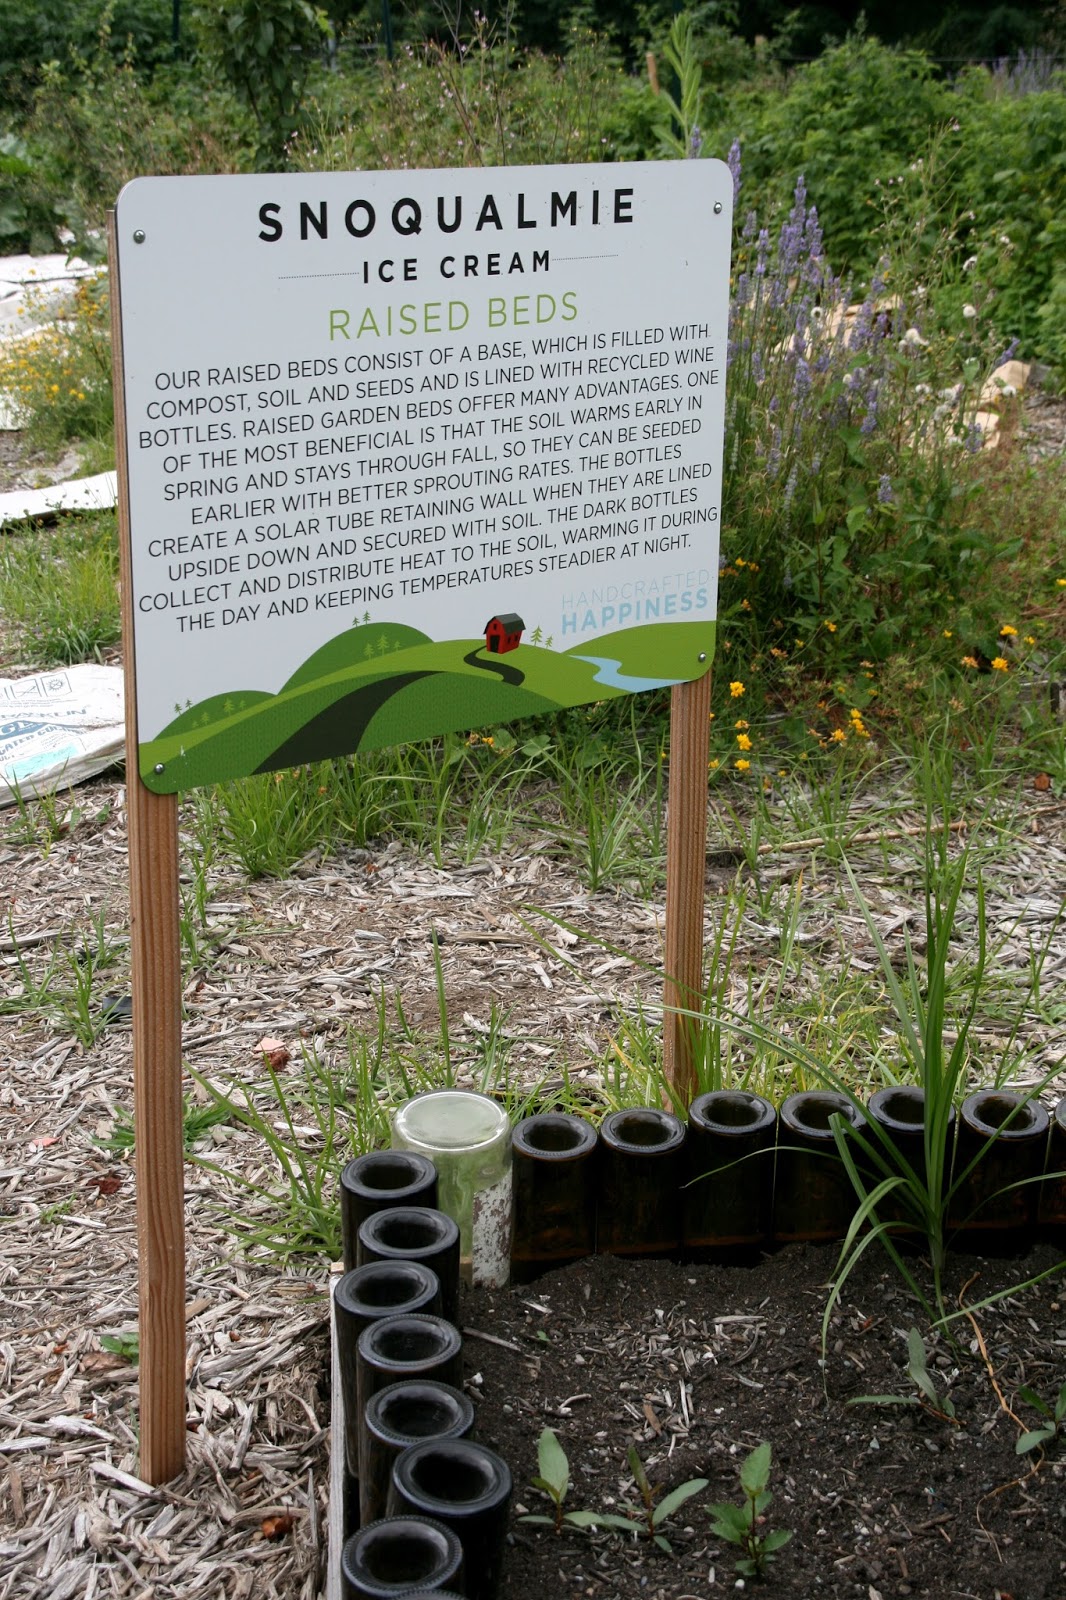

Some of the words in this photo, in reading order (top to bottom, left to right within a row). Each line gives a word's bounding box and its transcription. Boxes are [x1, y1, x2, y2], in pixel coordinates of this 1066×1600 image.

[258, 187, 634, 243] SNOQUALMIE
[363, 257, 418, 284] ICE
[439, 249, 550, 279] CREAM
[329, 300, 470, 341] RAISED
[488, 291, 578, 328] BEDS
[145, 392, 251, 421] COMPOST,
[257, 388, 303, 410] SOIL
[307, 383, 350, 405] AND
[355, 376, 415, 399] SEEDS
[419, 372, 460, 393] AND
[464, 370, 480, 388] IS
[484, 364, 535, 386] LINED
[539, 359, 583, 380] WITH
[587, 351, 670, 375] RECYCLED
[674, 346, 715, 366] WINE
[154, 369, 201, 391] OUR
[207, 362, 282, 387] RAISED
[287, 357, 339, 380] BEDS
[343, 349, 424, 374] CONSIST
[428, 346, 455, 366] OF
[458, 345, 473, 364] A
[477, 340, 527, 361] BASE,
[531, 334, 588, 356] WHICH
[592, 332, 607, 350] IS
[611, 327, 665, 348] FILLED
[668, 322, 709, 342] WITH
[138, 422, 237, 450] BOTTLES.
[242, 413, 315, 438] RAISED
[320, 404, 400, 429] GARDEN
[406, 398, 453, 420] BEDS
[457, 392, 516, 414] OFFER
[520, 385, 570, 407] MANY
[573, 373, 683, 401] ADVANTAGES.
[686, 368, 720, 388] ONE
[162, 453, 193, 474] OF
[197, 448, 239, 470] THE
[244, 441, 300, 465] MOST
[305, 428, 415, 458] BENEFICIAL
[420, 425, 436, 444] IS
[439, 419, 486, 441] THAT
[490, 415, 524, 436] THE
[527, 411, 566, 431] SOIL
[570, 403, 631, 426] WARMS
[634, 396, 684, 418] EARLY
[687, 394, 703, 411] IN
[163, 475, 239, 502] SPRING
[244, 470, 289, 492] AND
[294, 461, 352, 485] STAYS
[356, 449, 447, 477] THROUGH
[452, 444, 498, 465] FALL,
[502, 440, 527, 459] SO
[530, 433, 575, 455] THEY
[578, 428, 613, 449] CAN
[617, 425, 638, 444] BE
[641, 418, 702, 440] SEEDED
[191, 497, 276, 526] EARLIER
[281, 489, 332, 513] WITH
[337, 480, 408, 506] BETTER
[413, 466, 514, 495] SPROUTING
[518, 458, 574, 481] RATES.
[578, 453, 610, 472] THE
[614, 443, 682, 468] BOTTLES
[147, 530, 229, 558] CREATE
[233, 528, 249, 547] A
[254, 517, 321, 543] SOLAR
[325, 509, 375, 533] TUBE
[380, 496, 475, 526] RETAINING
[479, 489, 528, 511] WALL
[532, 480, 583, 503] WHEN
[587, 473, 630, 495] THEY
[632, 468, 665, 489] ARE
[668, 462, 713, 483] LINED
[168, 554, 241, 582] UPSIDE
[246, 544, 310, 571] DOWN
[315, 538, 358, 560] AND
[362, 525, 447, 553] SECURED
[451, 517, 496, 539] WITH
[501, 511, 543, 532] SOIL.
[546, 504, 579, 525] THE
[583, 497, 627, 519] DARK
[630, 486, 698, 512] BOTTLES
[138, 582, 233, 613] COLLECT
[237, 575, 282, 598] AND
[287, 557, 395, 590] DISTRIBUTE
[400, 549, 447, 572] HEAT
[450, 545, 475, 564] TO
[478, 538, 512, 559] THE
[516, 533, 557, 553] SOIL,
[561, 518, 639, 546] WARMING
[643, 515, 658, 533] IT
[661, 506, 718, 530] DURING
[175, 610, 216, 633] THE
[221, 603, 261, 626] DAY
[266, 596, 309, 619] AND
[315, 582, 394, 611] KEEPING
[398, 559, 534, 596] TEMPERATURES
[538, 545, 616, 573] STEADIER
[619, 541, 640, 560] AT
[643, 533, 692, 555] NIGHT.
[561, 569, 712, 611] HANDCRAFTED
[561, 587, 709, 636] HAPPINESS
